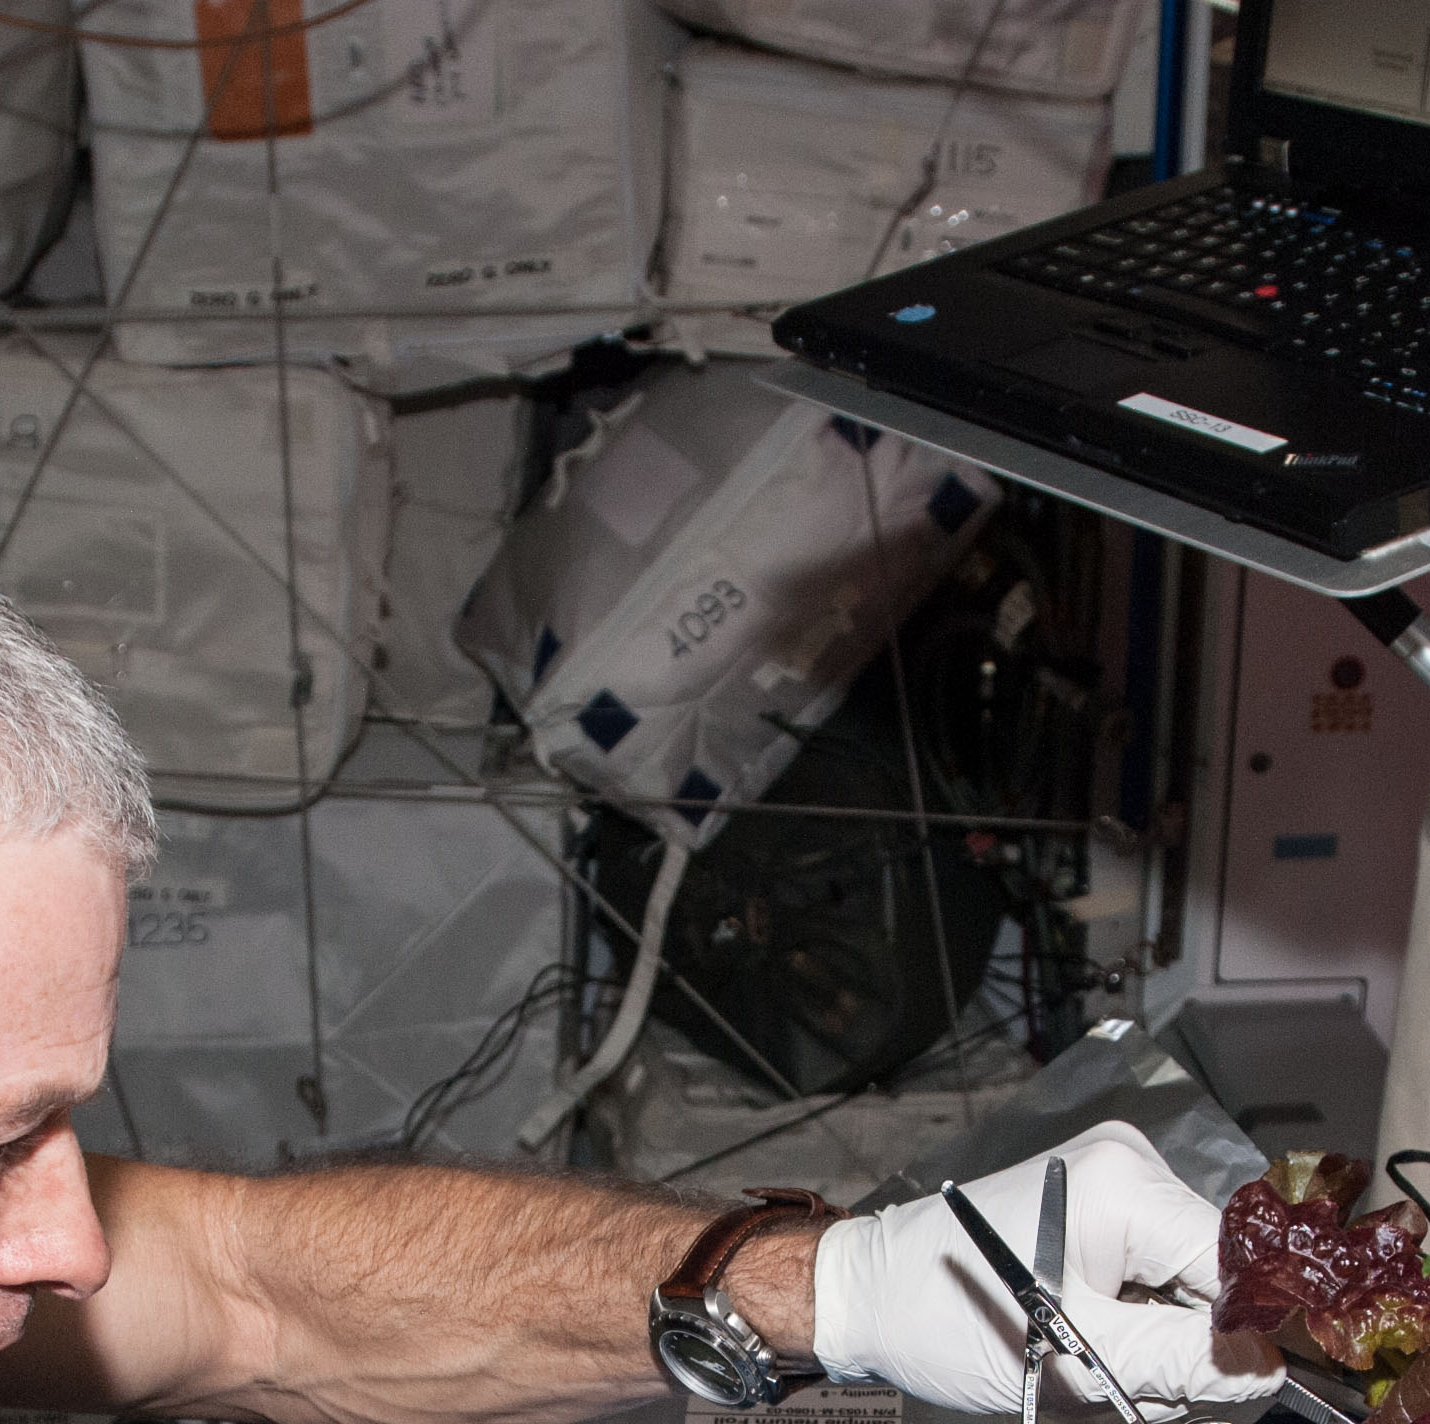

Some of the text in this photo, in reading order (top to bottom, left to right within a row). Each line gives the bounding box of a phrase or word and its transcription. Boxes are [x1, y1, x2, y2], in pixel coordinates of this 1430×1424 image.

[1171, 409, 1232, 433] SSC-13
[1283, 452, 1359, 466] ThinkPad
[668, 580, 748, 657] 4093
[1052, 1317, 1083, 1354] Veg-01
[840, 1389, 898, 1399] Quantity
[1092, 1367, 1136, 1423] Large Scissors
[874, 1407, 897, 1416] P/N
